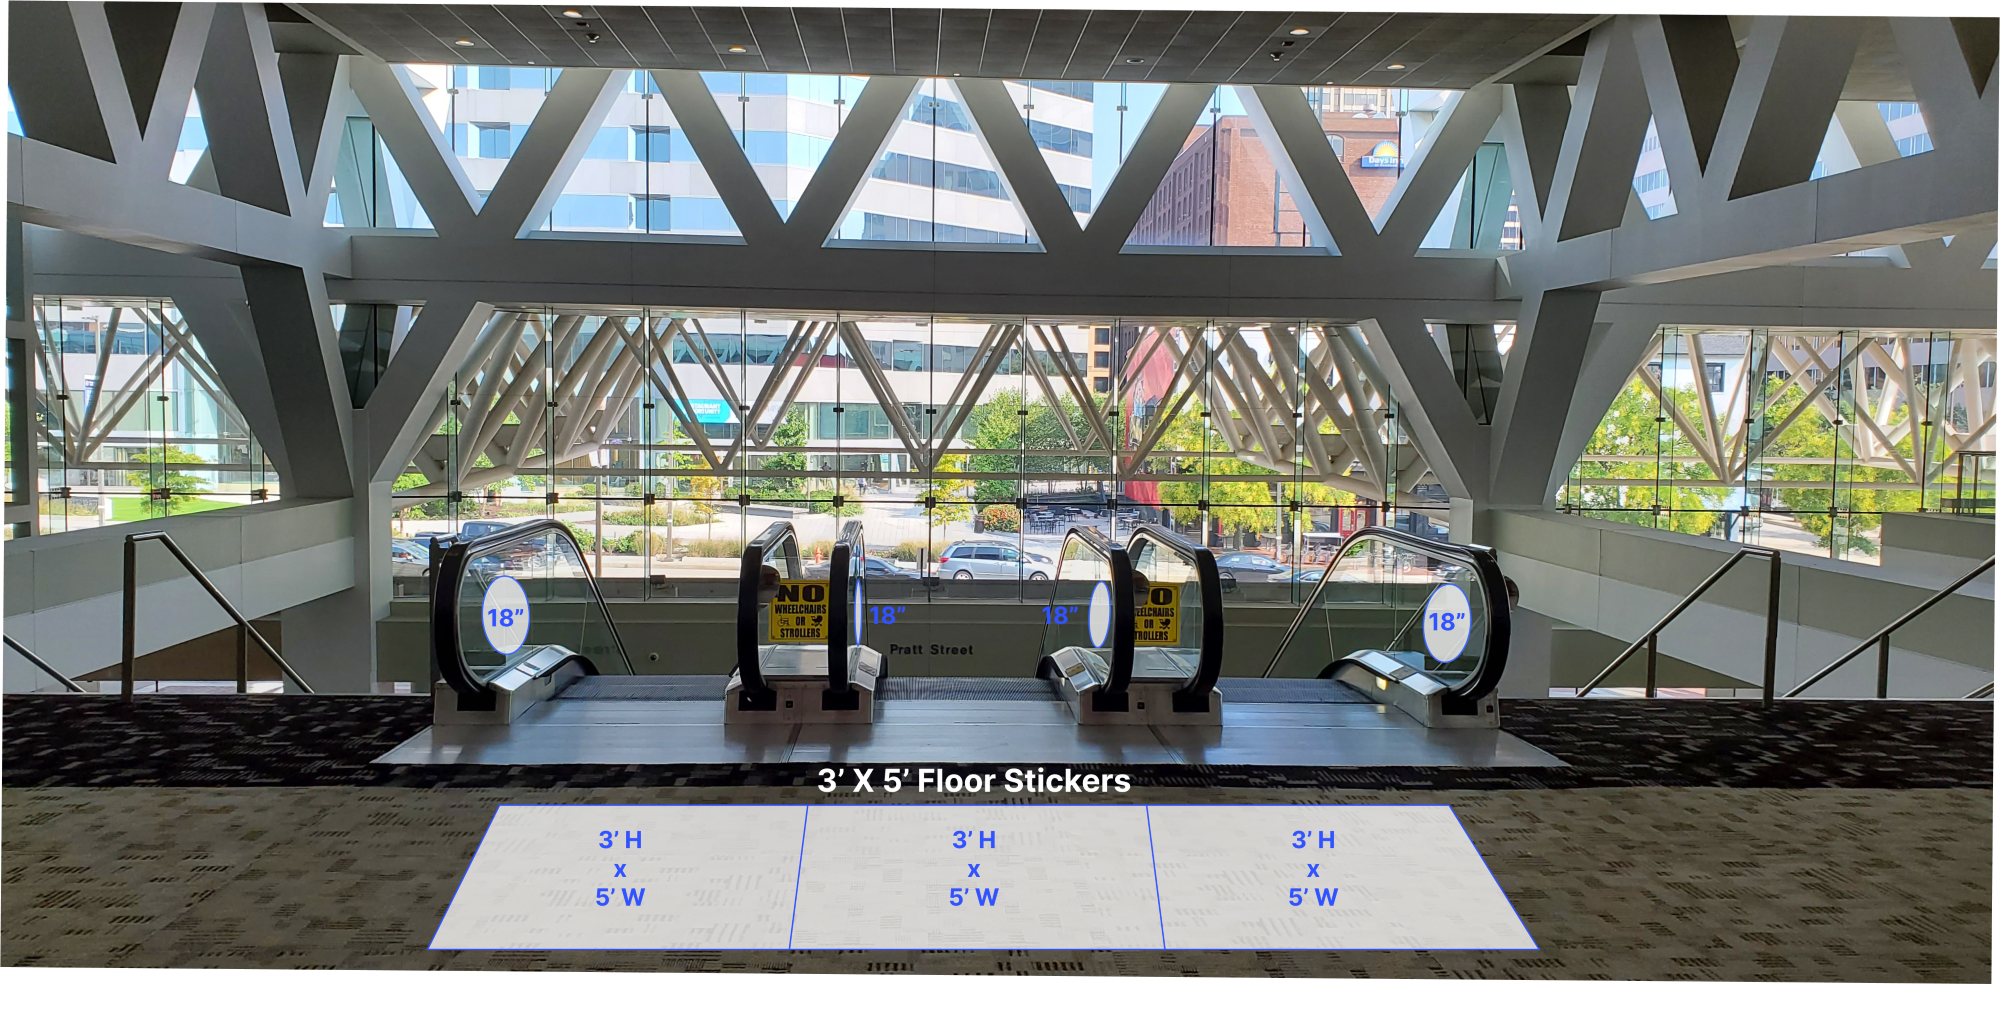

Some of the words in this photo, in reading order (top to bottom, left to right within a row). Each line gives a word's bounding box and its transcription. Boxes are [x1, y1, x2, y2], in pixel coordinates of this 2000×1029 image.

[777, 585, 825, 602] NO
[1151, 588, 1172, 605] O
[775, 604, 827, 614] WHEELCHAIRS
[795, 616, 806, 626] OR
[1143, 619, 1154, 629] OR
[780, 628, 821, 638] STROLLERS
[1135, 631, 1168, 640] TROLLERS
[890, 644, 923, 655] Pratt
[930, 644, 973, 655] Street
